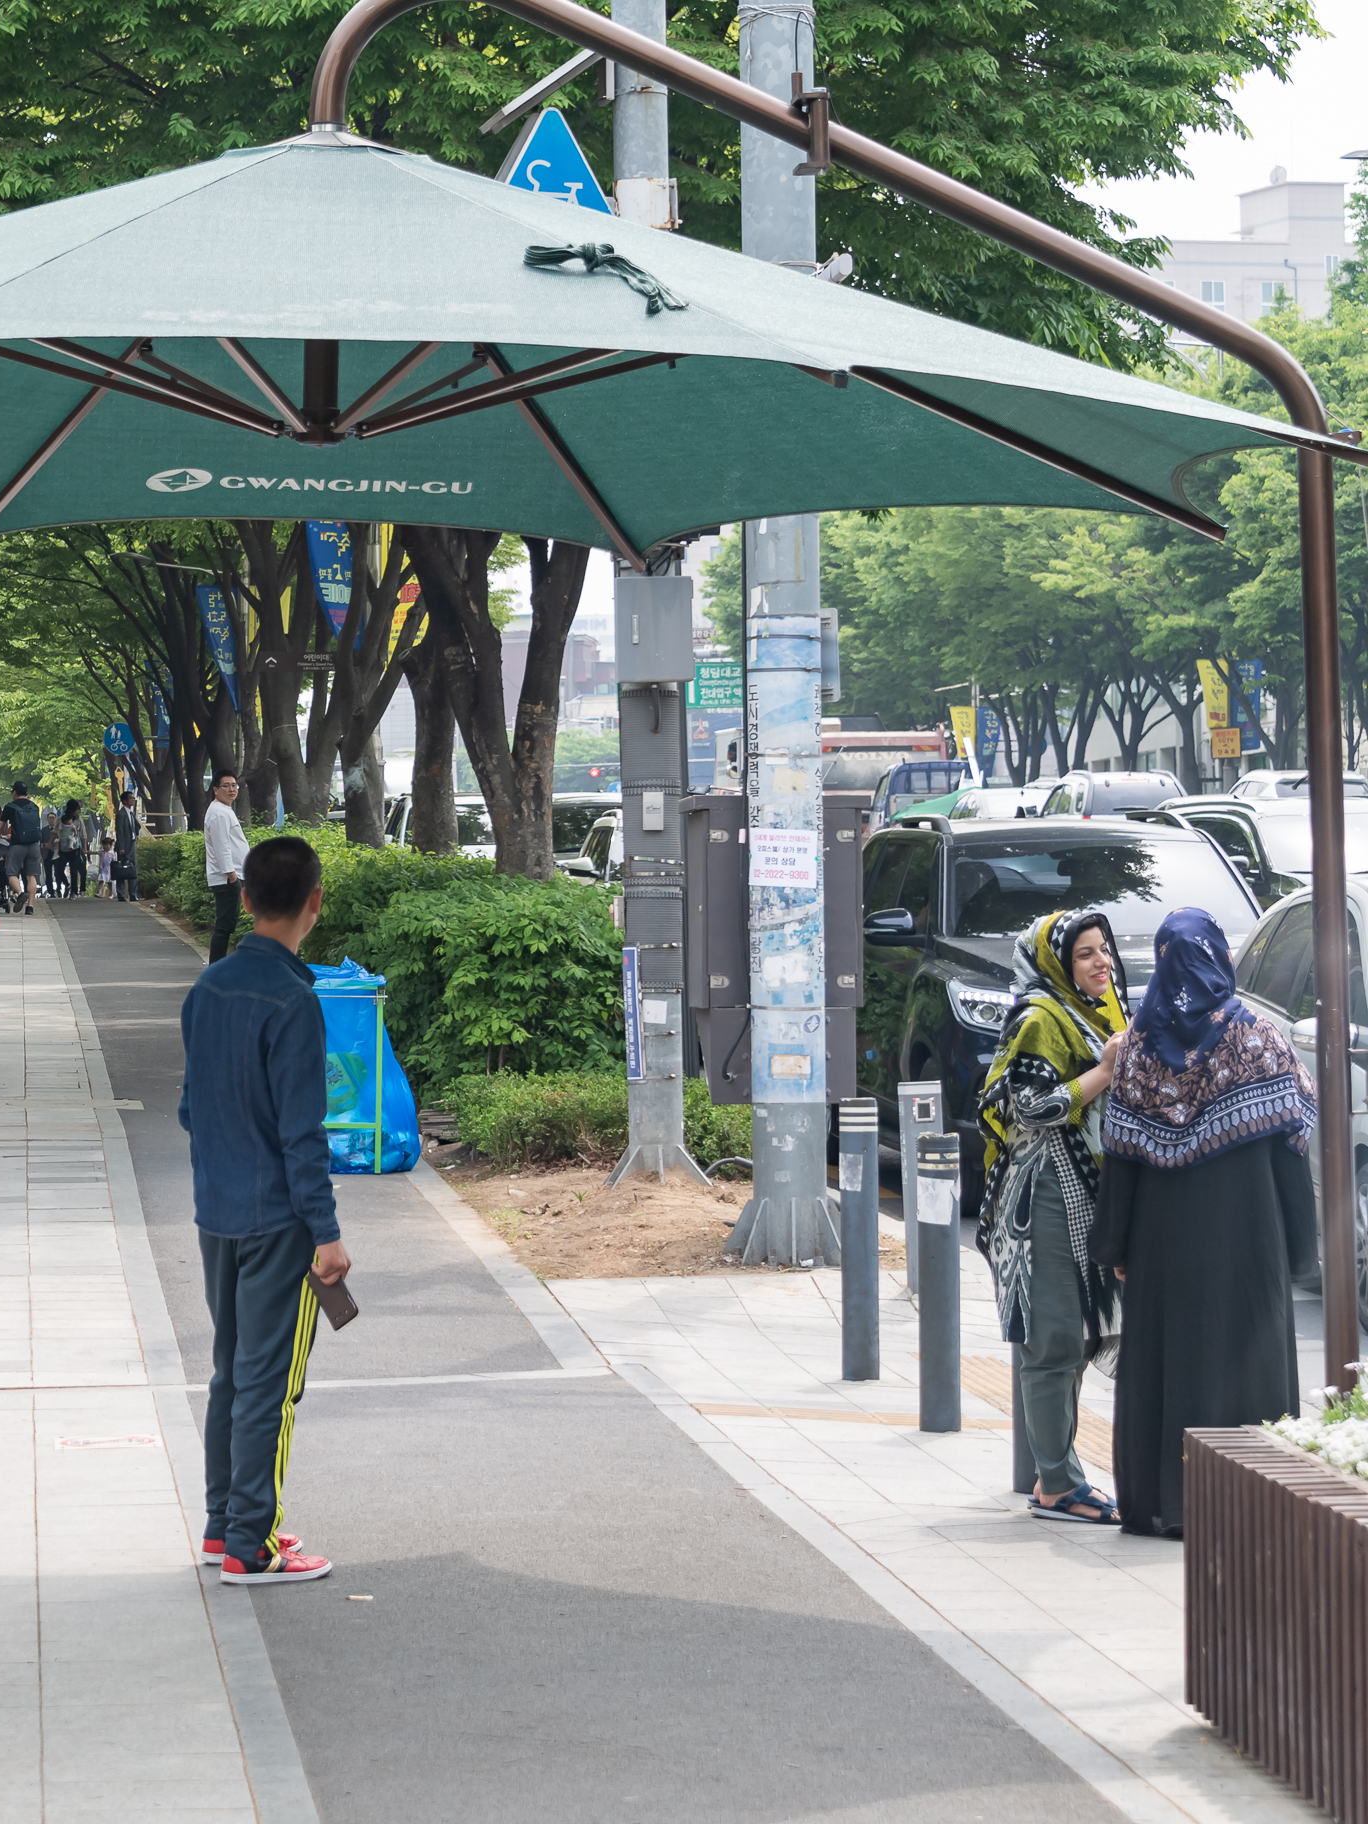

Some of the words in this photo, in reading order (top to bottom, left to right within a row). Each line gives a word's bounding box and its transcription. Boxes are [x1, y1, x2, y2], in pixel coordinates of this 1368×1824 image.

[218, 476, 474, 495] GWANGJIN-GU
[700, 666, 741, 678] 청담대교
[839, 751, 910, 761] VOLVO
[764, 856, 778, 865] 문의
[781, 857, 796, 866] 상담
[753, 868, 809, 880] 02-2022-9300
